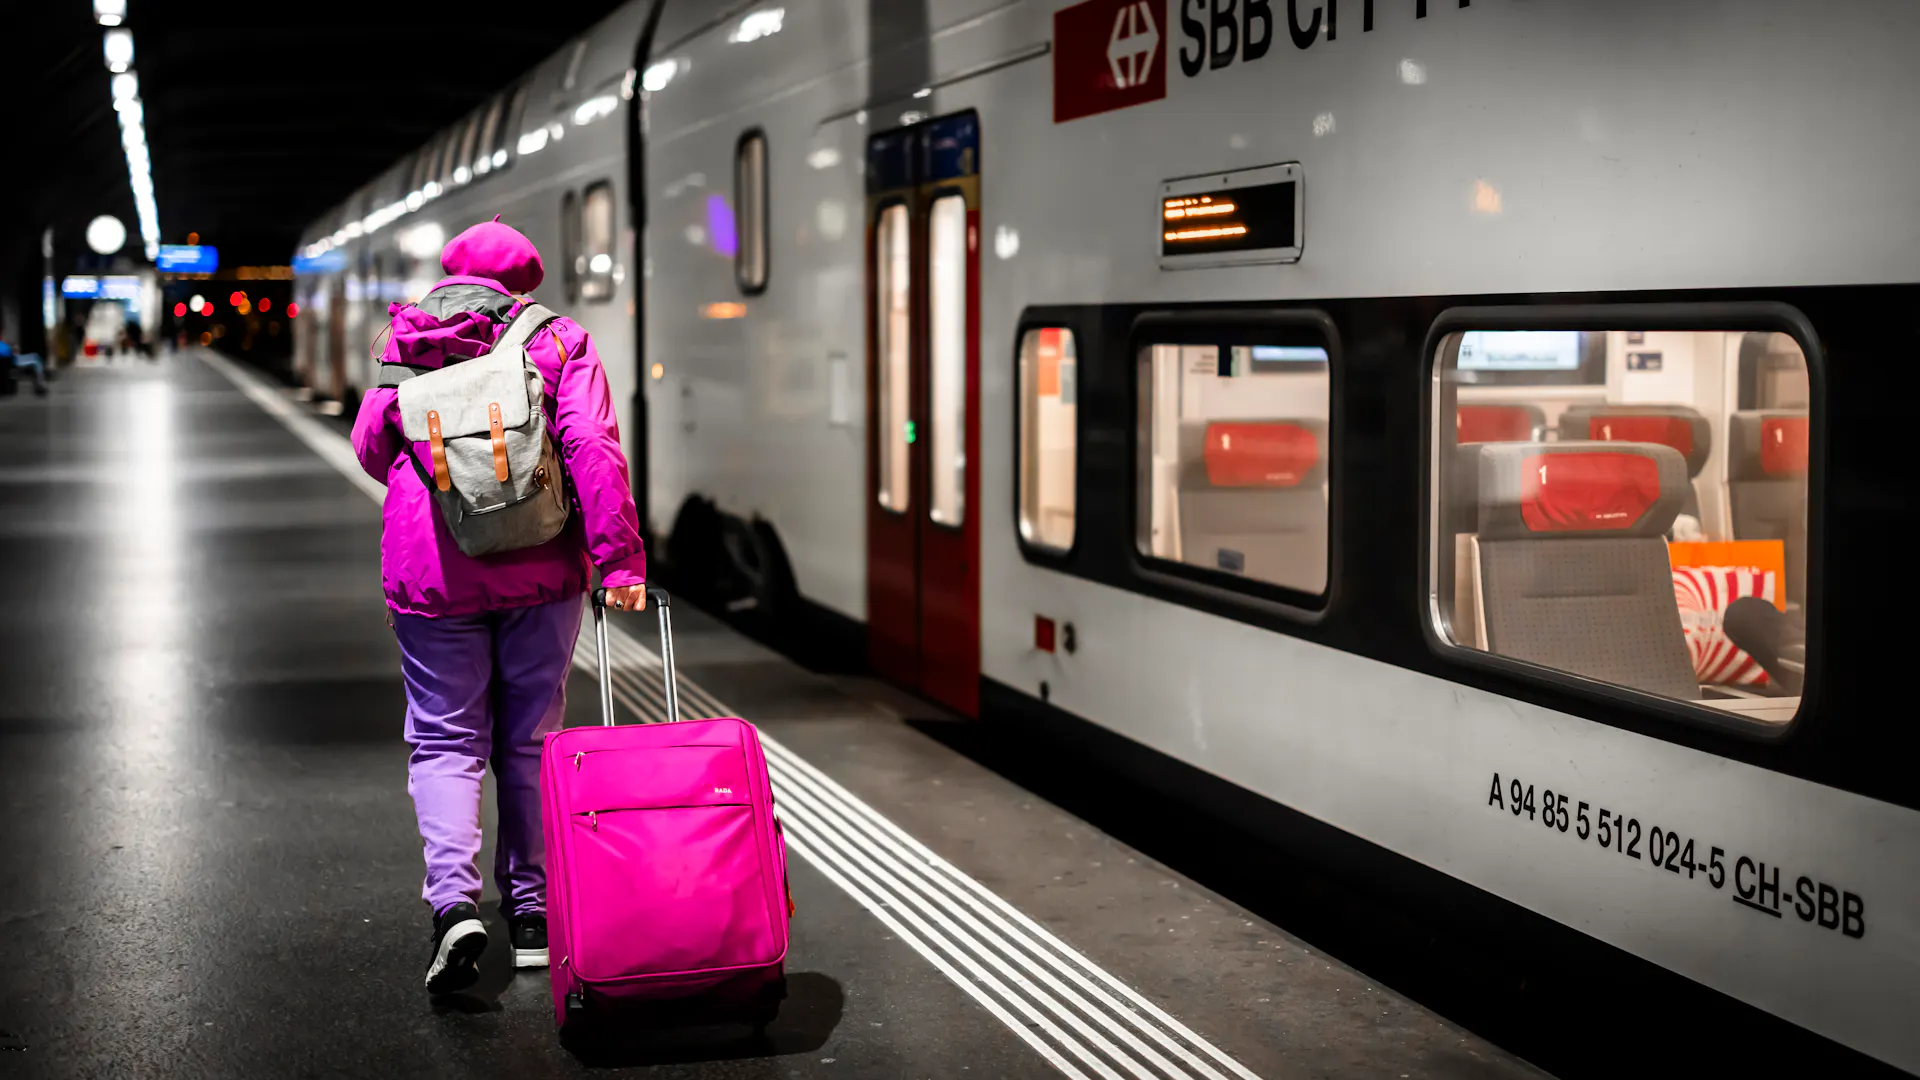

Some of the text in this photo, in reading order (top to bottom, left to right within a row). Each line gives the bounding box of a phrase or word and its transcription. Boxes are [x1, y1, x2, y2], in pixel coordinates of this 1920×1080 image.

[1179, 0, 1273, 77] SBB
[1539, 465, 1547, 485] 1
[1488, 773, 1865, 939] A 94 85 5 512 024-5 CH-SBB
